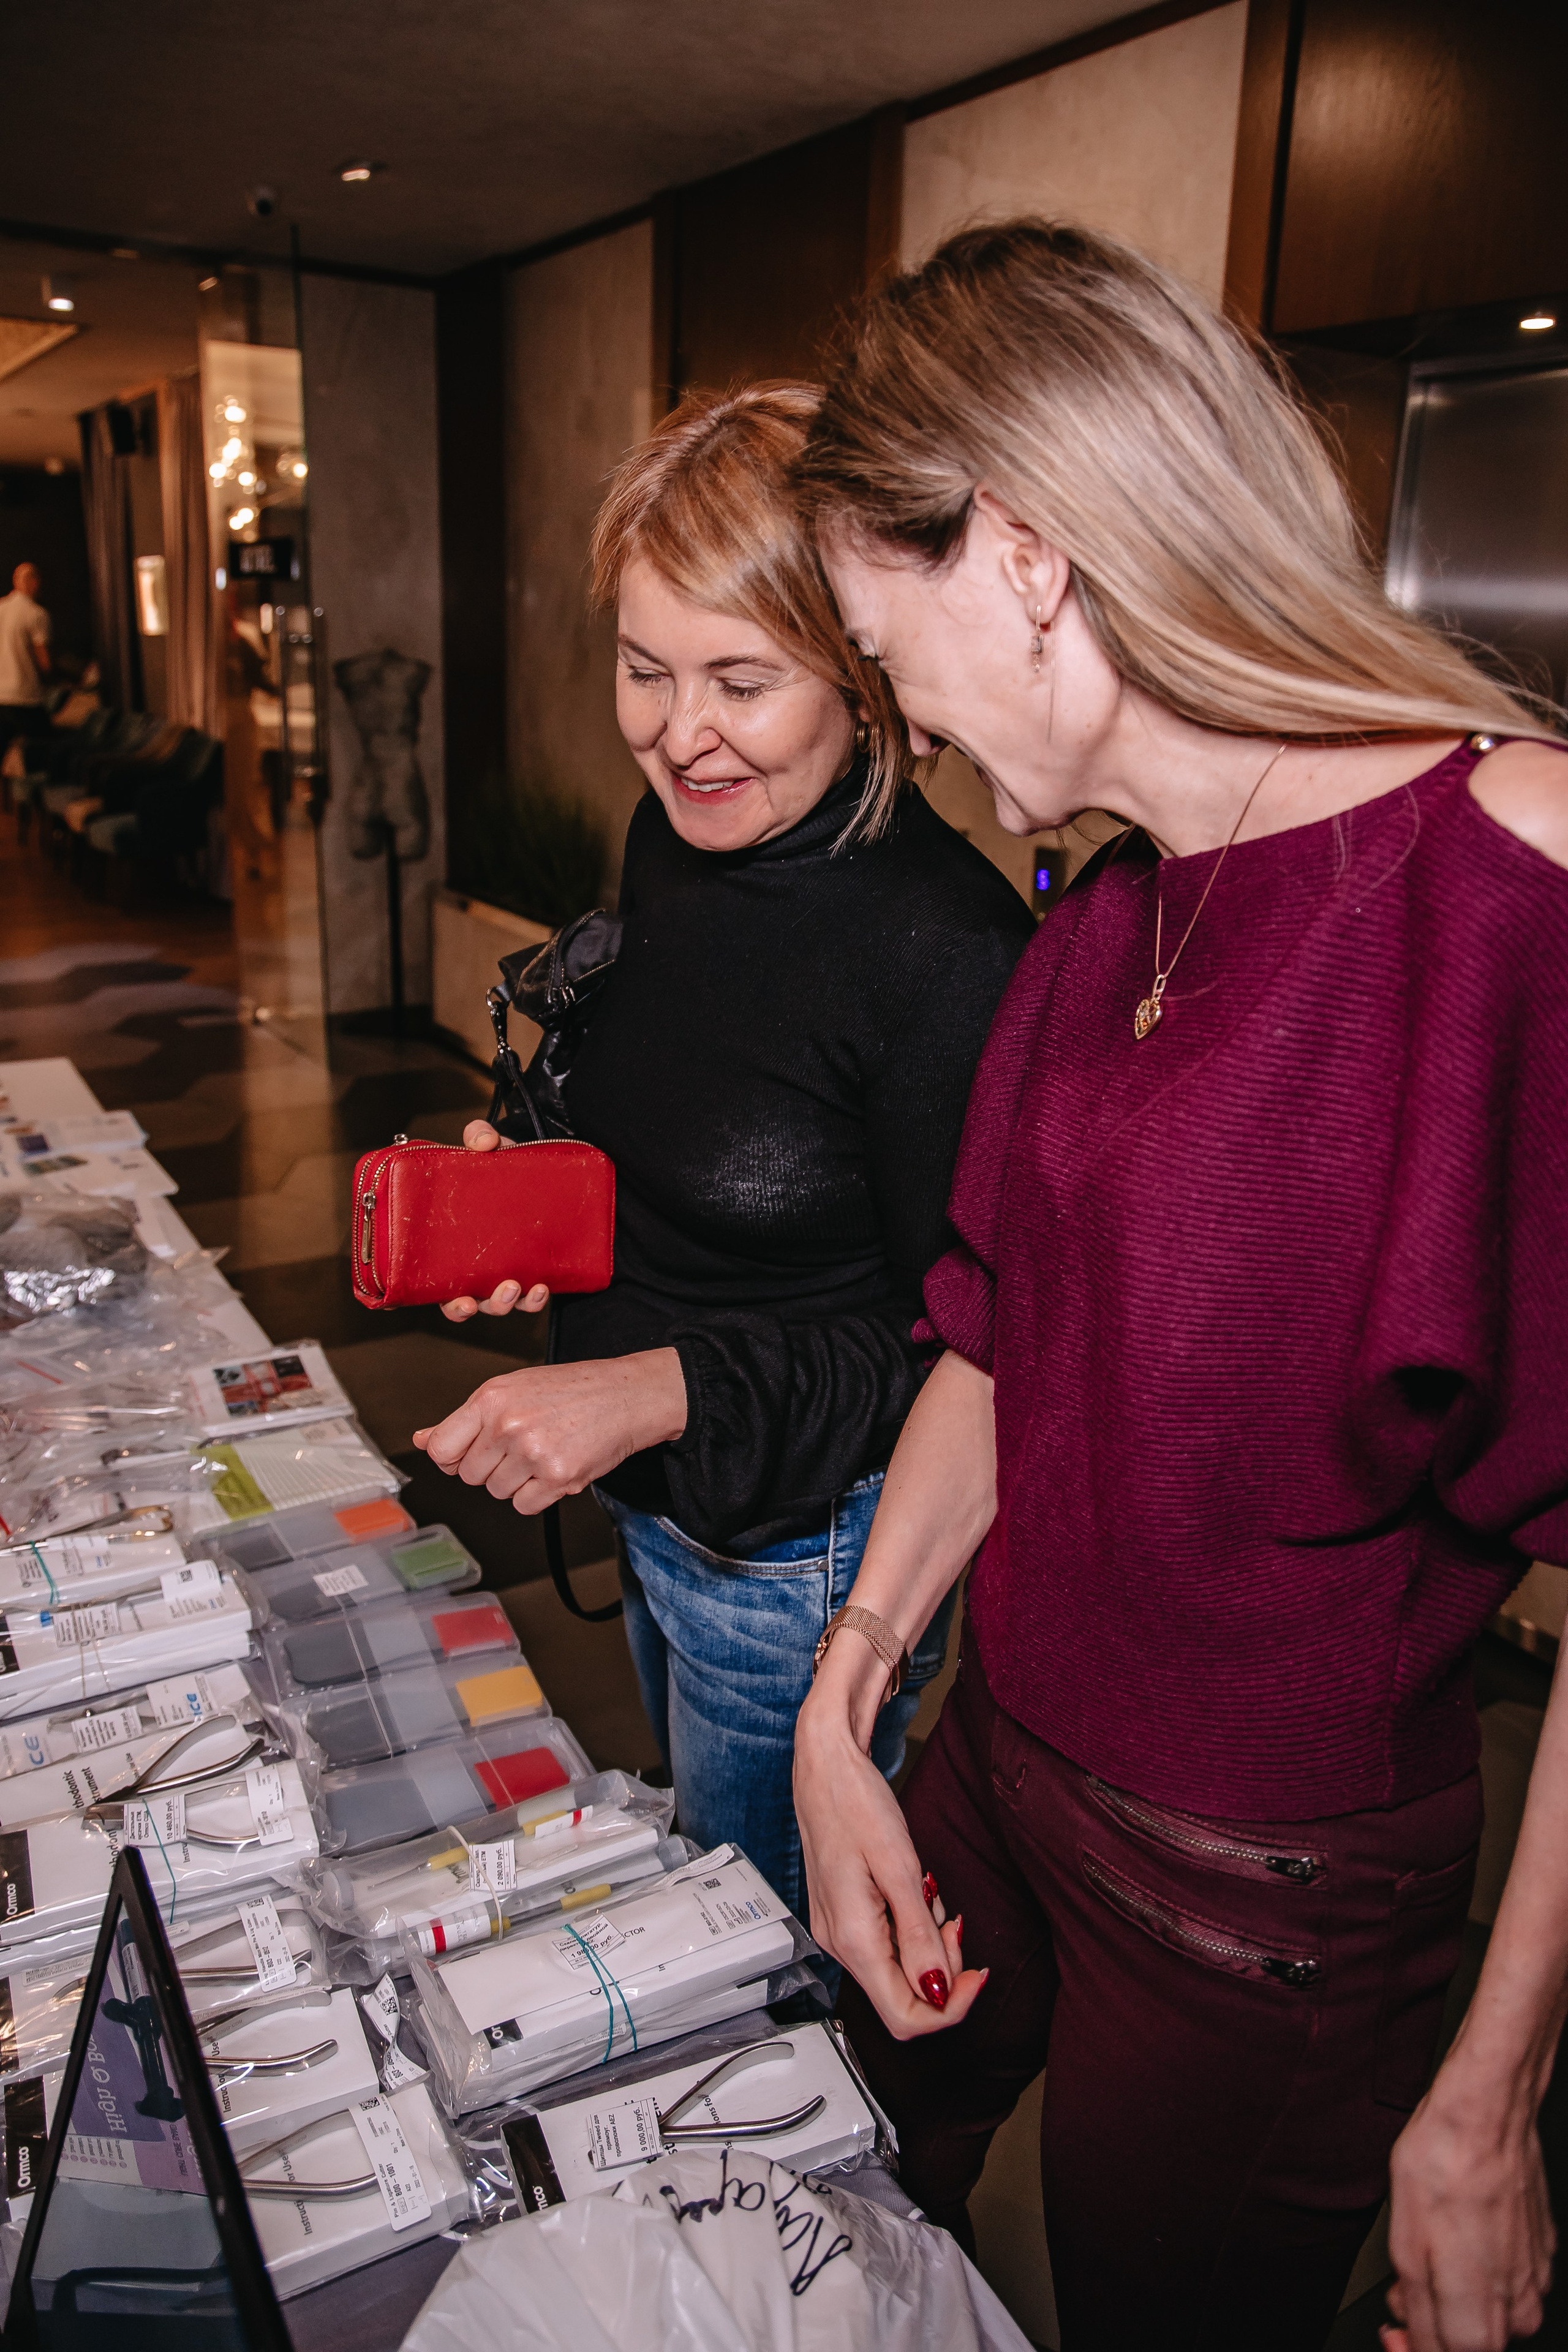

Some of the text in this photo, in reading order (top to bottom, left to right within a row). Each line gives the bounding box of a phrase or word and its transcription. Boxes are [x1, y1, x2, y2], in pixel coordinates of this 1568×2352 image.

[64, 1770, 85, 1808] thodontic
[81, 1767, 102, 1803] strument
[7, 1882, 18, 1916] Ormco
[745, 1901, 761, 1920] Ormco
[211, 2041, 220, 2057] Use
[633, 2107, 644, 2121] руб.
[612, 2126, 622, 2157] проволоки
[636, 2123, 646, 2145] 000,00
[18, 2146, 31, 2188] Ormco
[533, 2186, 548, 2211] mco
